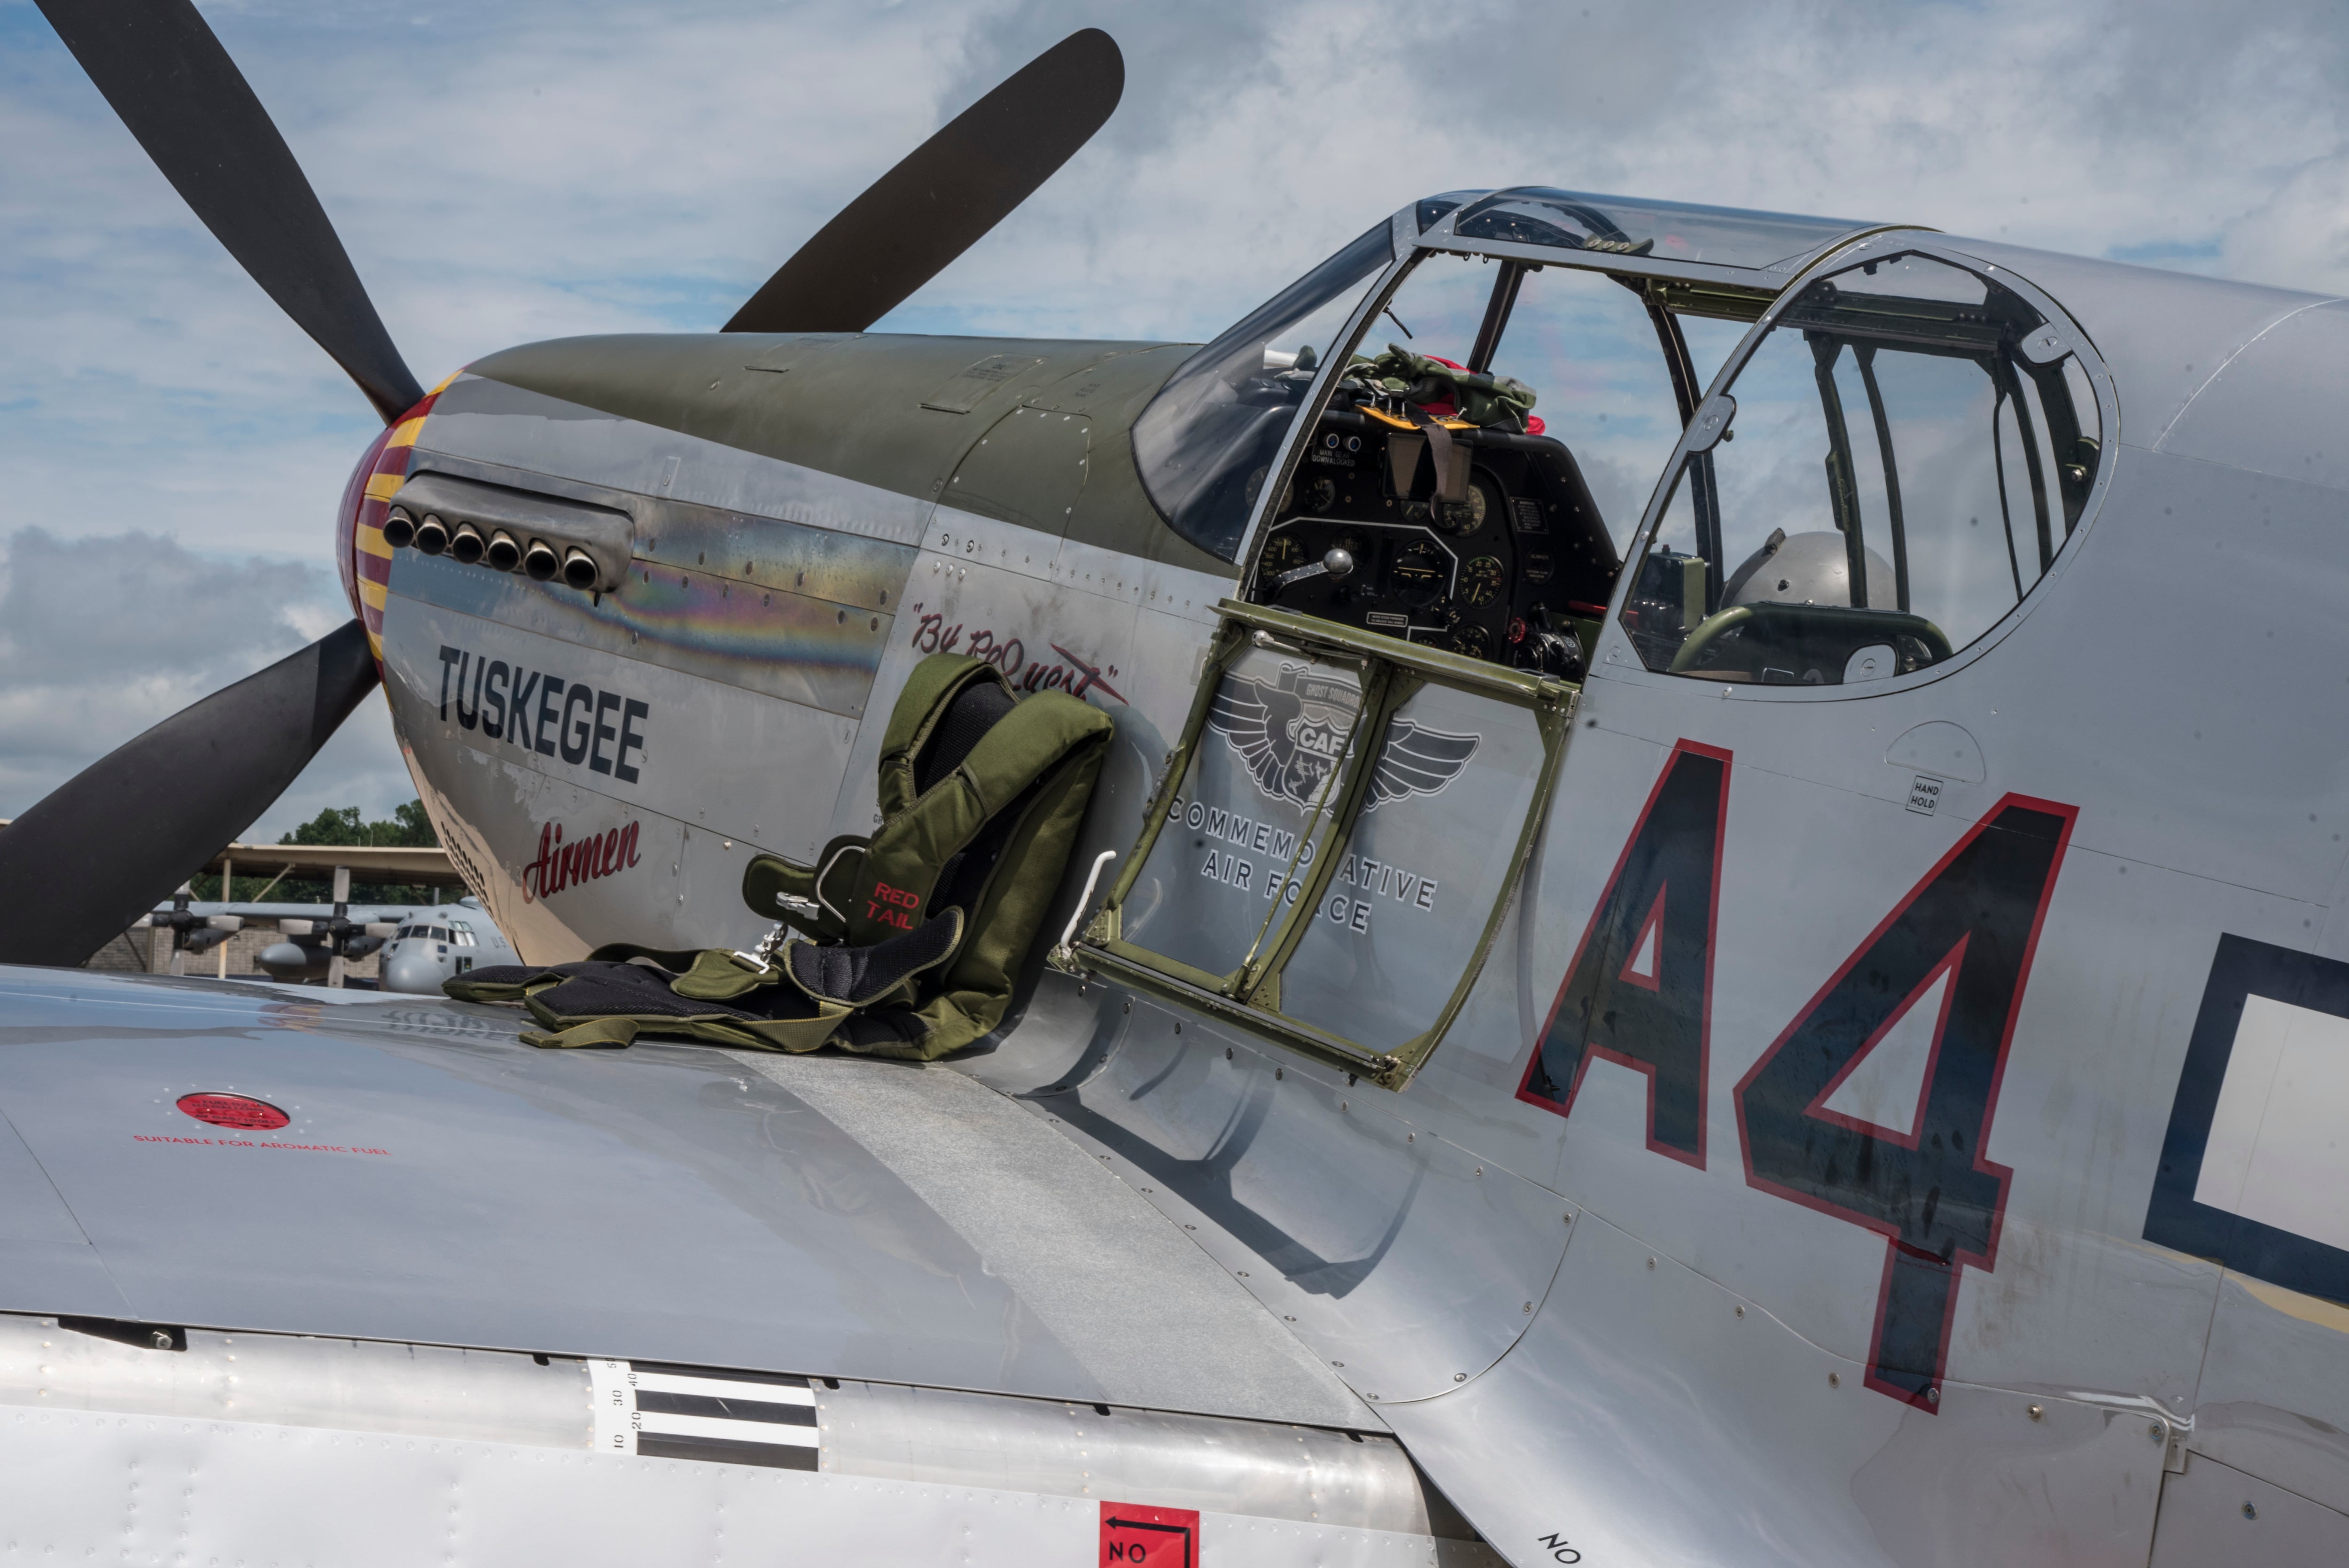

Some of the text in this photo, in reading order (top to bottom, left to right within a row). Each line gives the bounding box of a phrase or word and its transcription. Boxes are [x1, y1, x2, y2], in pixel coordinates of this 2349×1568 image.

[1319, 449, 1350, 459] MAIN GEAR
[1306, 683, 1361, 709] GHOST SQUADRO
[439, 645, 649, 784] TUSKEGEE
[1299, 728, 1346, 754] CAF
[1914, 782, 1939, 795] HAND
[1911, 795, 1935, 808] HOLD
[522, 820, 641, 904] Airmen
[1167, 796, 1438, 912] COMMEMOATIVE
[873, 881, 920, 909] RED
[1201, 848, 1372, 935] AIR FOCE
[866, 900, 914, 930] TAIL
[133, 1135, 214, 1145] SUITABLE
[261, 1142, 348, 1153] AROMATIC
[627, 1373, 638, 1387] 40
[612, 1390, 623, 1406] 30
[631, 1412, 641, 1429] 20
[614, 1435, 623, 1448] 10
[1109, 1541, 1146, 1564] NO
[1537, 1533, 1581, 1564] NO
